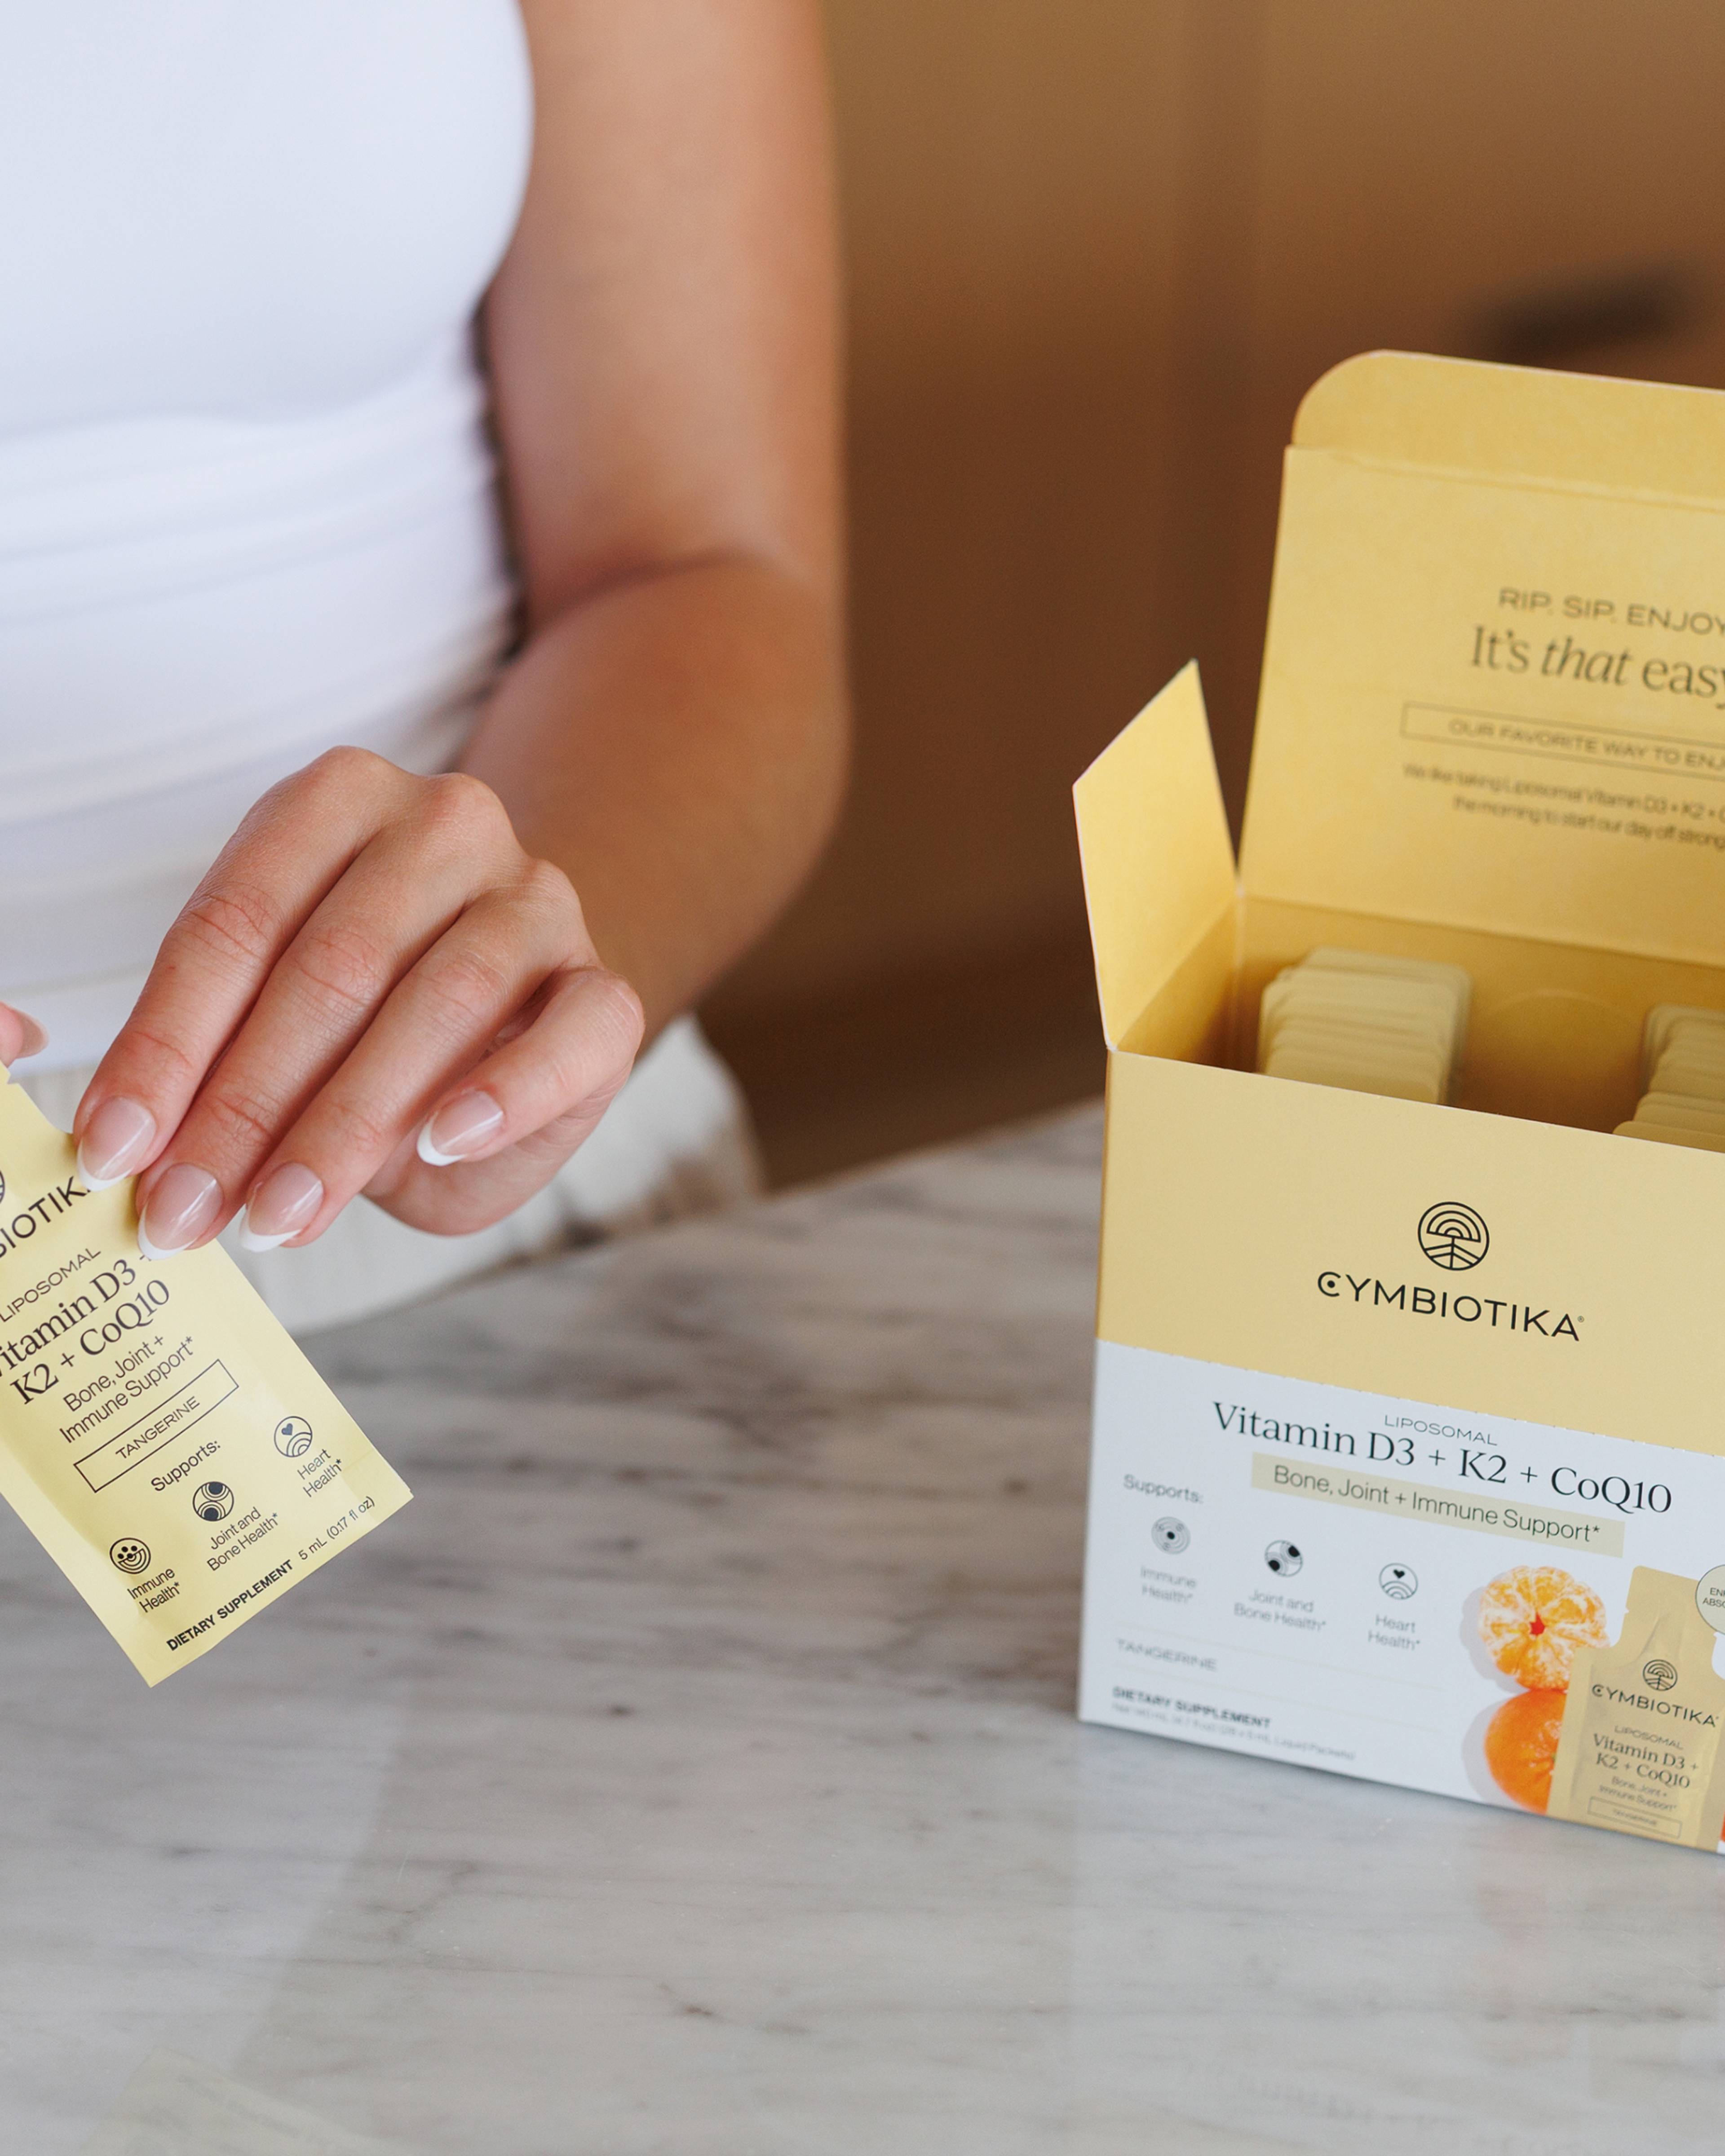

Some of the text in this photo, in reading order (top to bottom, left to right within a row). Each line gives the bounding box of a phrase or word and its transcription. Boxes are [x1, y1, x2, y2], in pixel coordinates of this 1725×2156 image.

[1499, 587, 1554, 615] RIP.
[1562, 594, 1617, 623] SIP.
[1541, 636, 1633, 686] that
[1448, 719, 1495, 737] OUR
[1499, 725, 1597, 754] FAVORITE
[1602, 741, 1648, 758] WAY
[1654, 745, 1681, 764] TO
[0, 1176, 90, 1258] IOTIK
[0, 1248, 101, 1322] LIPOSOMAL
[0, 1259, 136, 1377] itamin D3
[10, 1280, 169, 1405] K2 + CoQ10
[63, 1336, 164, 1412] Bone, Joint +
[59, 1393, 128, 1443] Immune
[115, 1396, 200, 1459] TANGERINE
[1384, 1414, 1498, 1445] LIPOSOMAL
[150, 1440, 221, 1491] Supports:
[297, 1449, 332, 1480] Heart
[1213, 1401, 1672, 1514] Vitamin D3 + K2 + CoQ10
[1123, 1474, 1204, 1504] Supports:
[1274, 1464, 1333, 1496] Bone,
[1338, 1479, 1389, 1505] Joint
[1395, 1493, 1407, 1505] +
[1412, 1492, 1498, 1524] Immune
[210, 1507, 261, 1550] Joint and
[166, 1496, 375, 1651] DIETARY SUPPLEMENT 5 mL (0.17 fl oz)
[207, 1545, 241, 1571] Bone
[1140, 1566, 1197, 1588] Immune
[127, 1568, 176, 1600] Immune
[1248, 1589, 1314, 1613] Joint and
[1710, 1587, 1725, 1597] EN
[1233, 1602, 1272, 1622] Bone
[1375, 1614, 1416, 1634] Heart
[1116, 1638, 1216, 1671] TANGERINE
[1112, 1685, 1171, 1707] DIETARY
[1175, 1699, 1271, 1728] SUPPLEMENT
[1593, 1733, 1659, 1763] Vitamin
[1663, 1753, 1685, 1770] D3
[1614, 1725, 1684, 1750] LIPOSOMAL
[1596, 1752, 1619, 1770] K2
[1637, 1763, 1690, 1788] CoQ10
